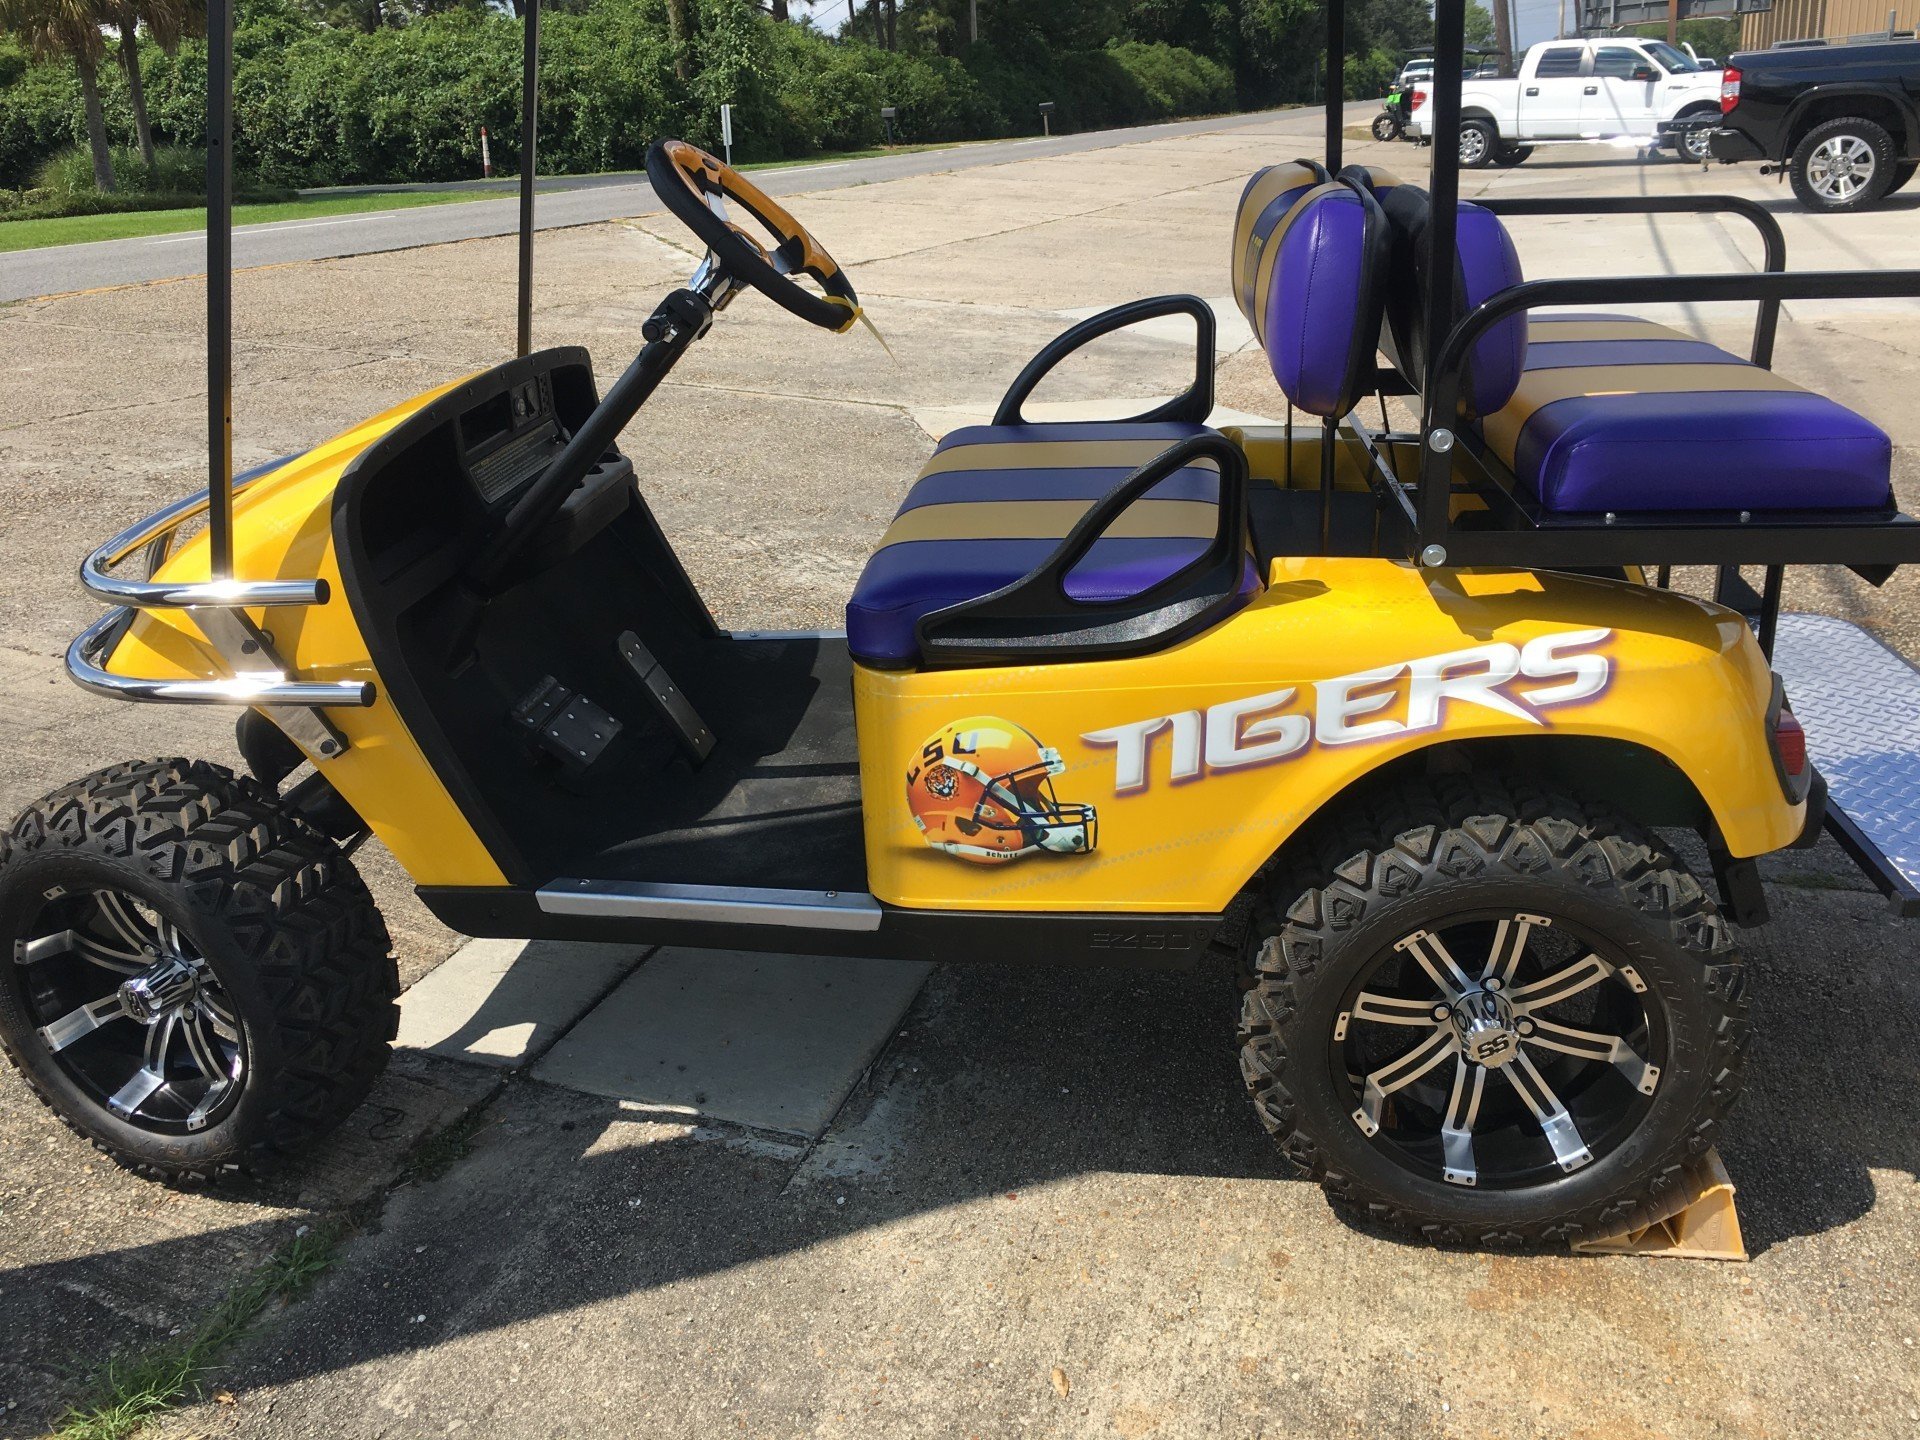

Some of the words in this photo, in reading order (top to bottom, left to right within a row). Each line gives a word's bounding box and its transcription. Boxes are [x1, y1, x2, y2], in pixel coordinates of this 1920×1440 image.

[1079, 627, 1612, 791] TIGERS
[907, 732, 978, 786] LSU
[1477, 1033, 1510, 1060] SS
